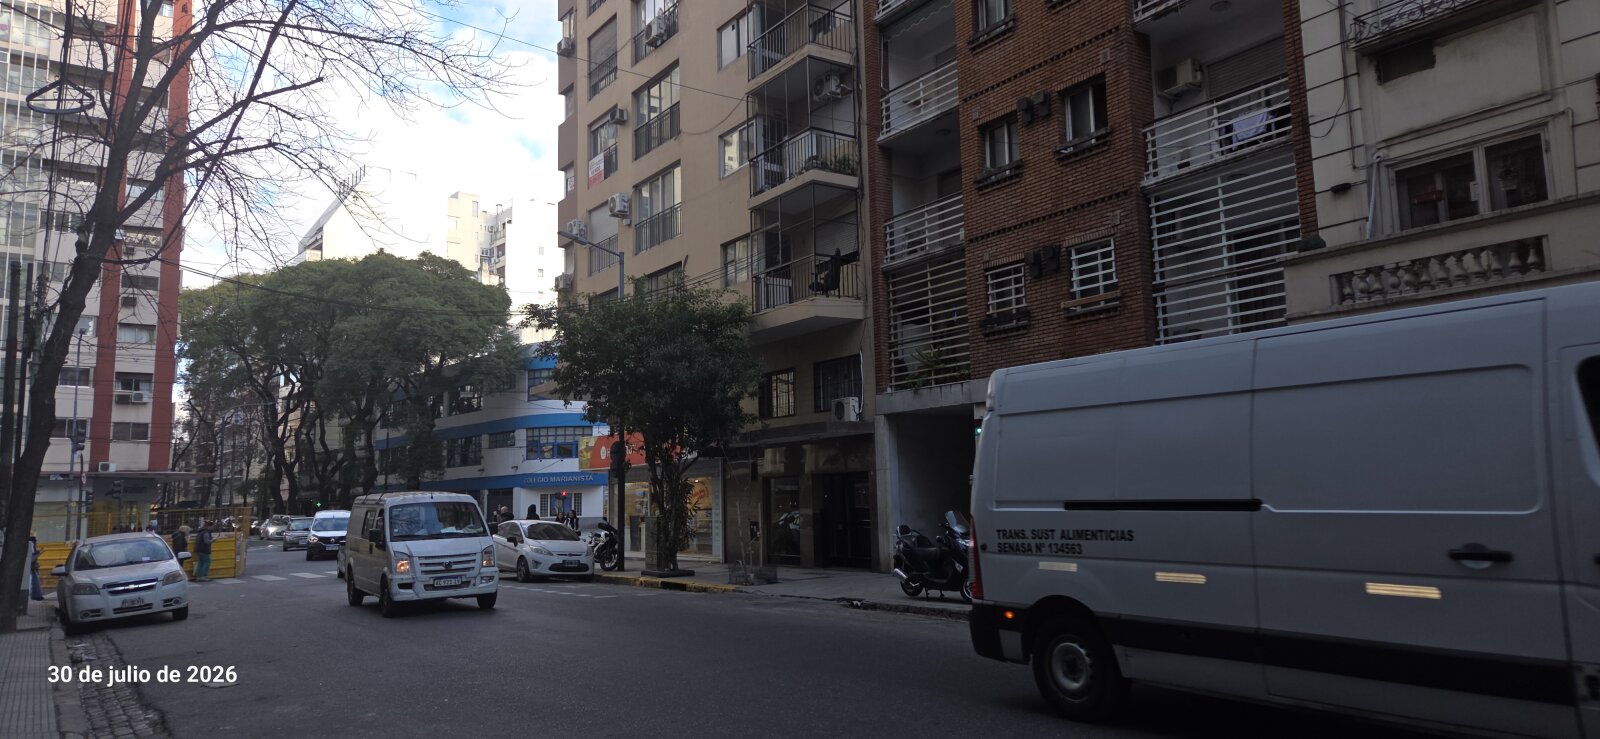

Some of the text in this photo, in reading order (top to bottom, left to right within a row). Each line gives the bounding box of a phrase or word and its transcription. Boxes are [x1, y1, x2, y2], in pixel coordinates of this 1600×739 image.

[524, 475, 594, 484] COLEGIO MARIANISTA
[996, 529, 1134, 542] TRANS. SUST ALIMENTICIAS
[997, 542, 1032, 553] SENASA
[1048, 543, 1083, 555] 134563
